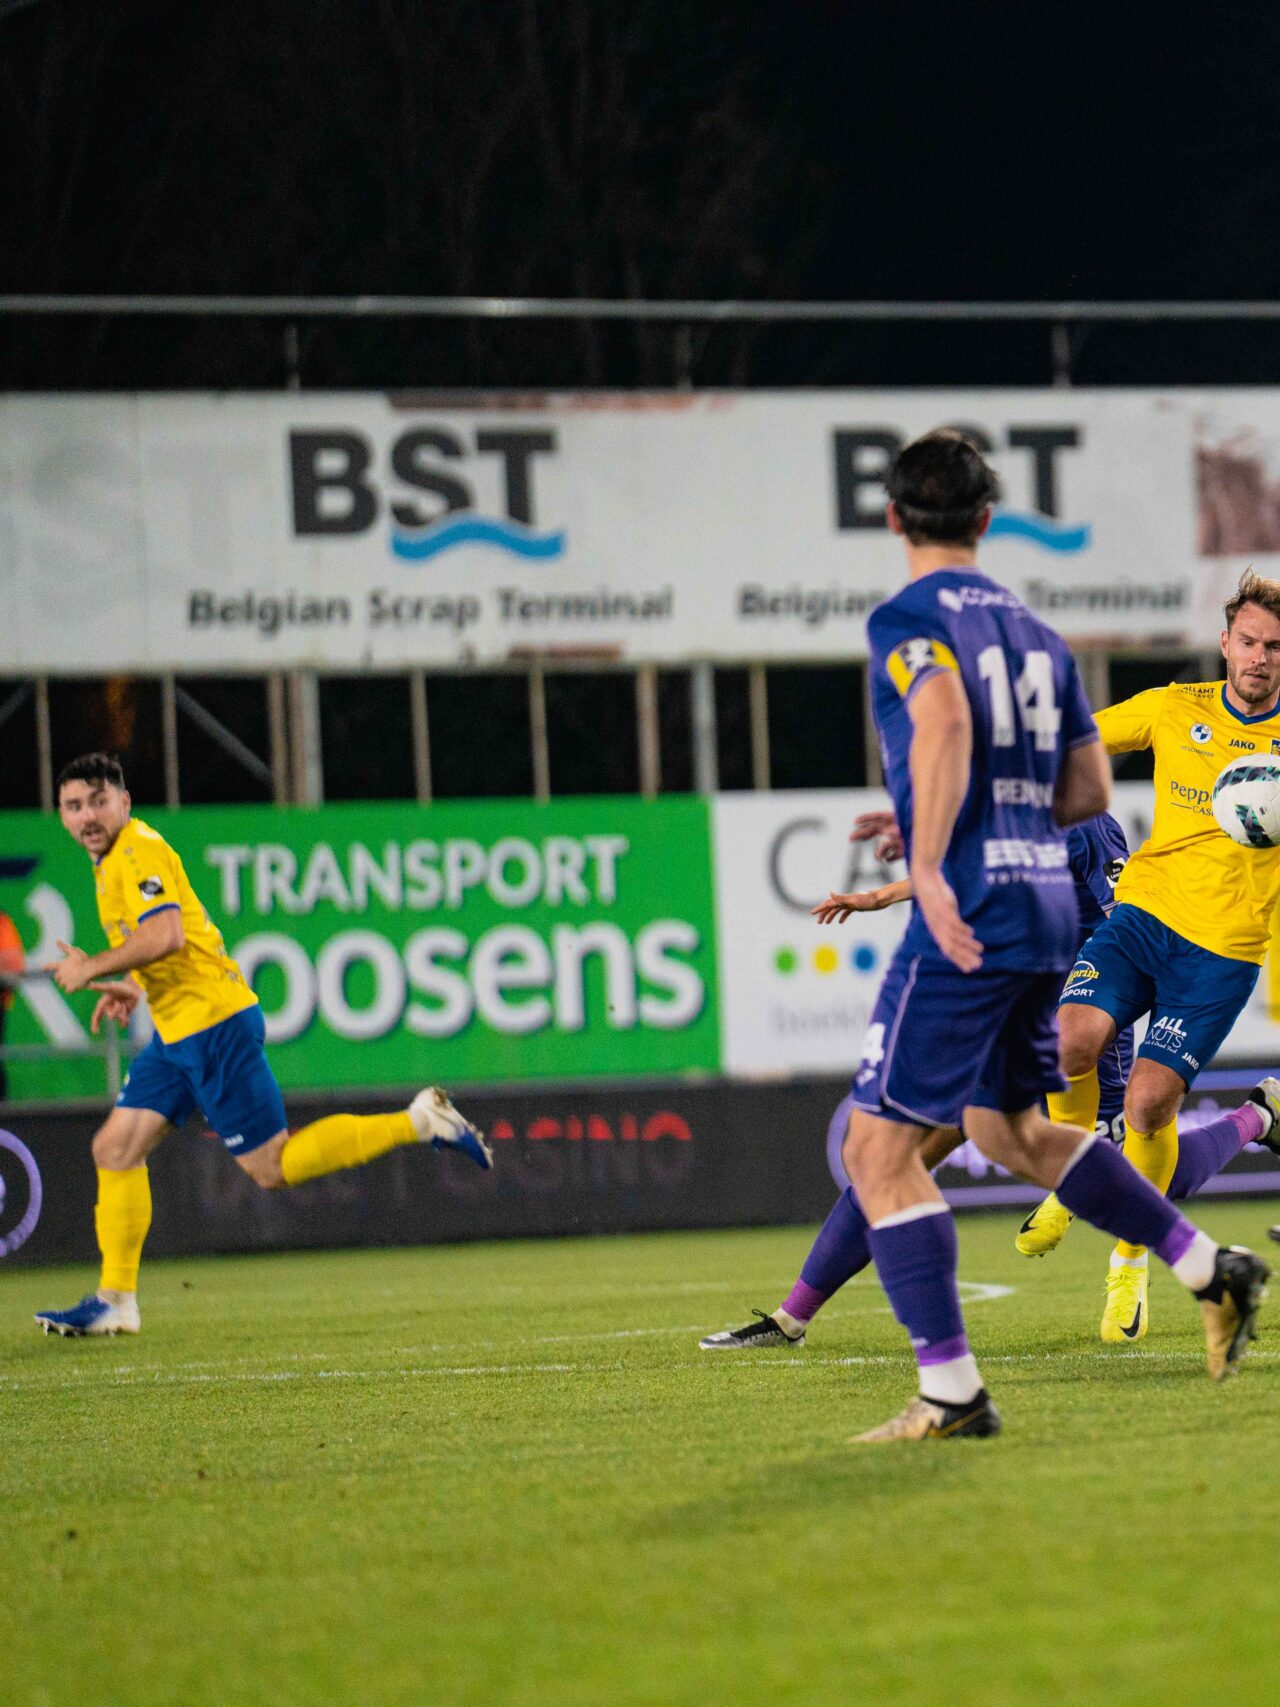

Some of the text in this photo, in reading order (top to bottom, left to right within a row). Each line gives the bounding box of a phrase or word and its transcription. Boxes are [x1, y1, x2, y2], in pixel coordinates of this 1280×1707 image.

[286, 425, 560, 538] BST
[830, 424, 1082, 532] BT
[188, 585, 674, 638] Belgian Scrap Terminal
[977, 645, 1063, 751] 14
[1228, 738, 1256, 751] JAKO
[1170, 780, 1213, 805] Pepp
[206, 833, 630, 917] TRANSPORT
[135, 917, 707, 1046] oosens
